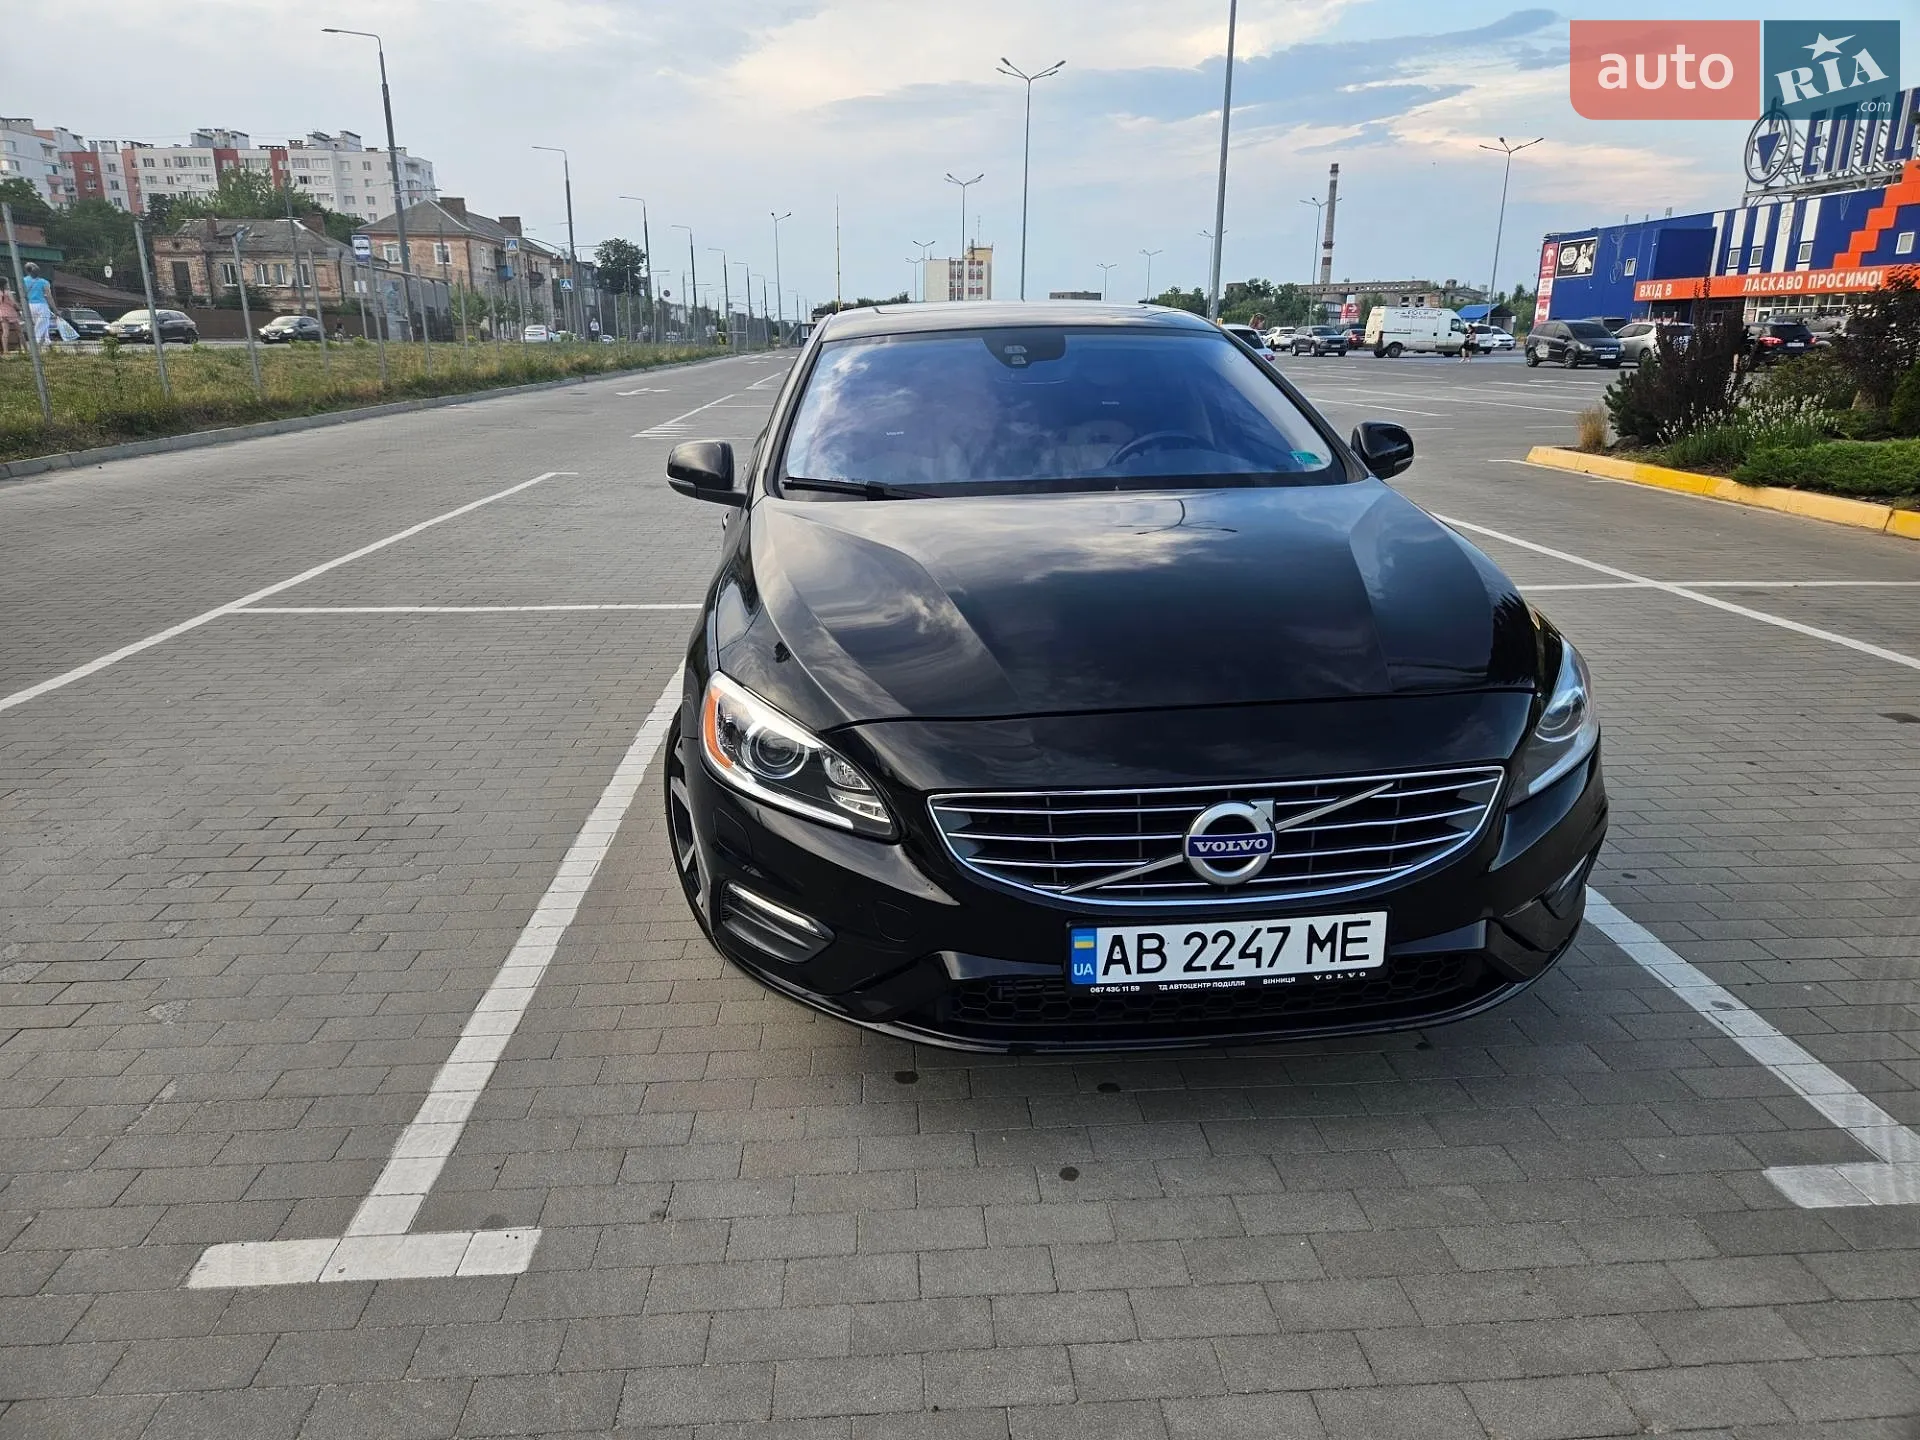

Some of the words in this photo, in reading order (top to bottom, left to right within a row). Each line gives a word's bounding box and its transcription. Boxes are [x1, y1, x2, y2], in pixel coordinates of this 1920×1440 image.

[1743, 275, 1803, 293] ЛАСКАВО
[1807, 270, 1883, 290] ПРОСИМО!
[1639, 283, 1662, 299] ВХІД
[1193, 838, 1268, 853] VOLVO
[1102, 933, 1168, 976] AB
[1182, 925, 1291, 972] 2247
[1306, 920, 1372, 965] ME
[1073, 963, 1094, 976] UA
[1313, 971, 1366, 981] VOLVO
[1169, 982, 1212, 990] АВТОЦЕНТР
[1263, 976, 1296, 985] ВІННИЦЯ
